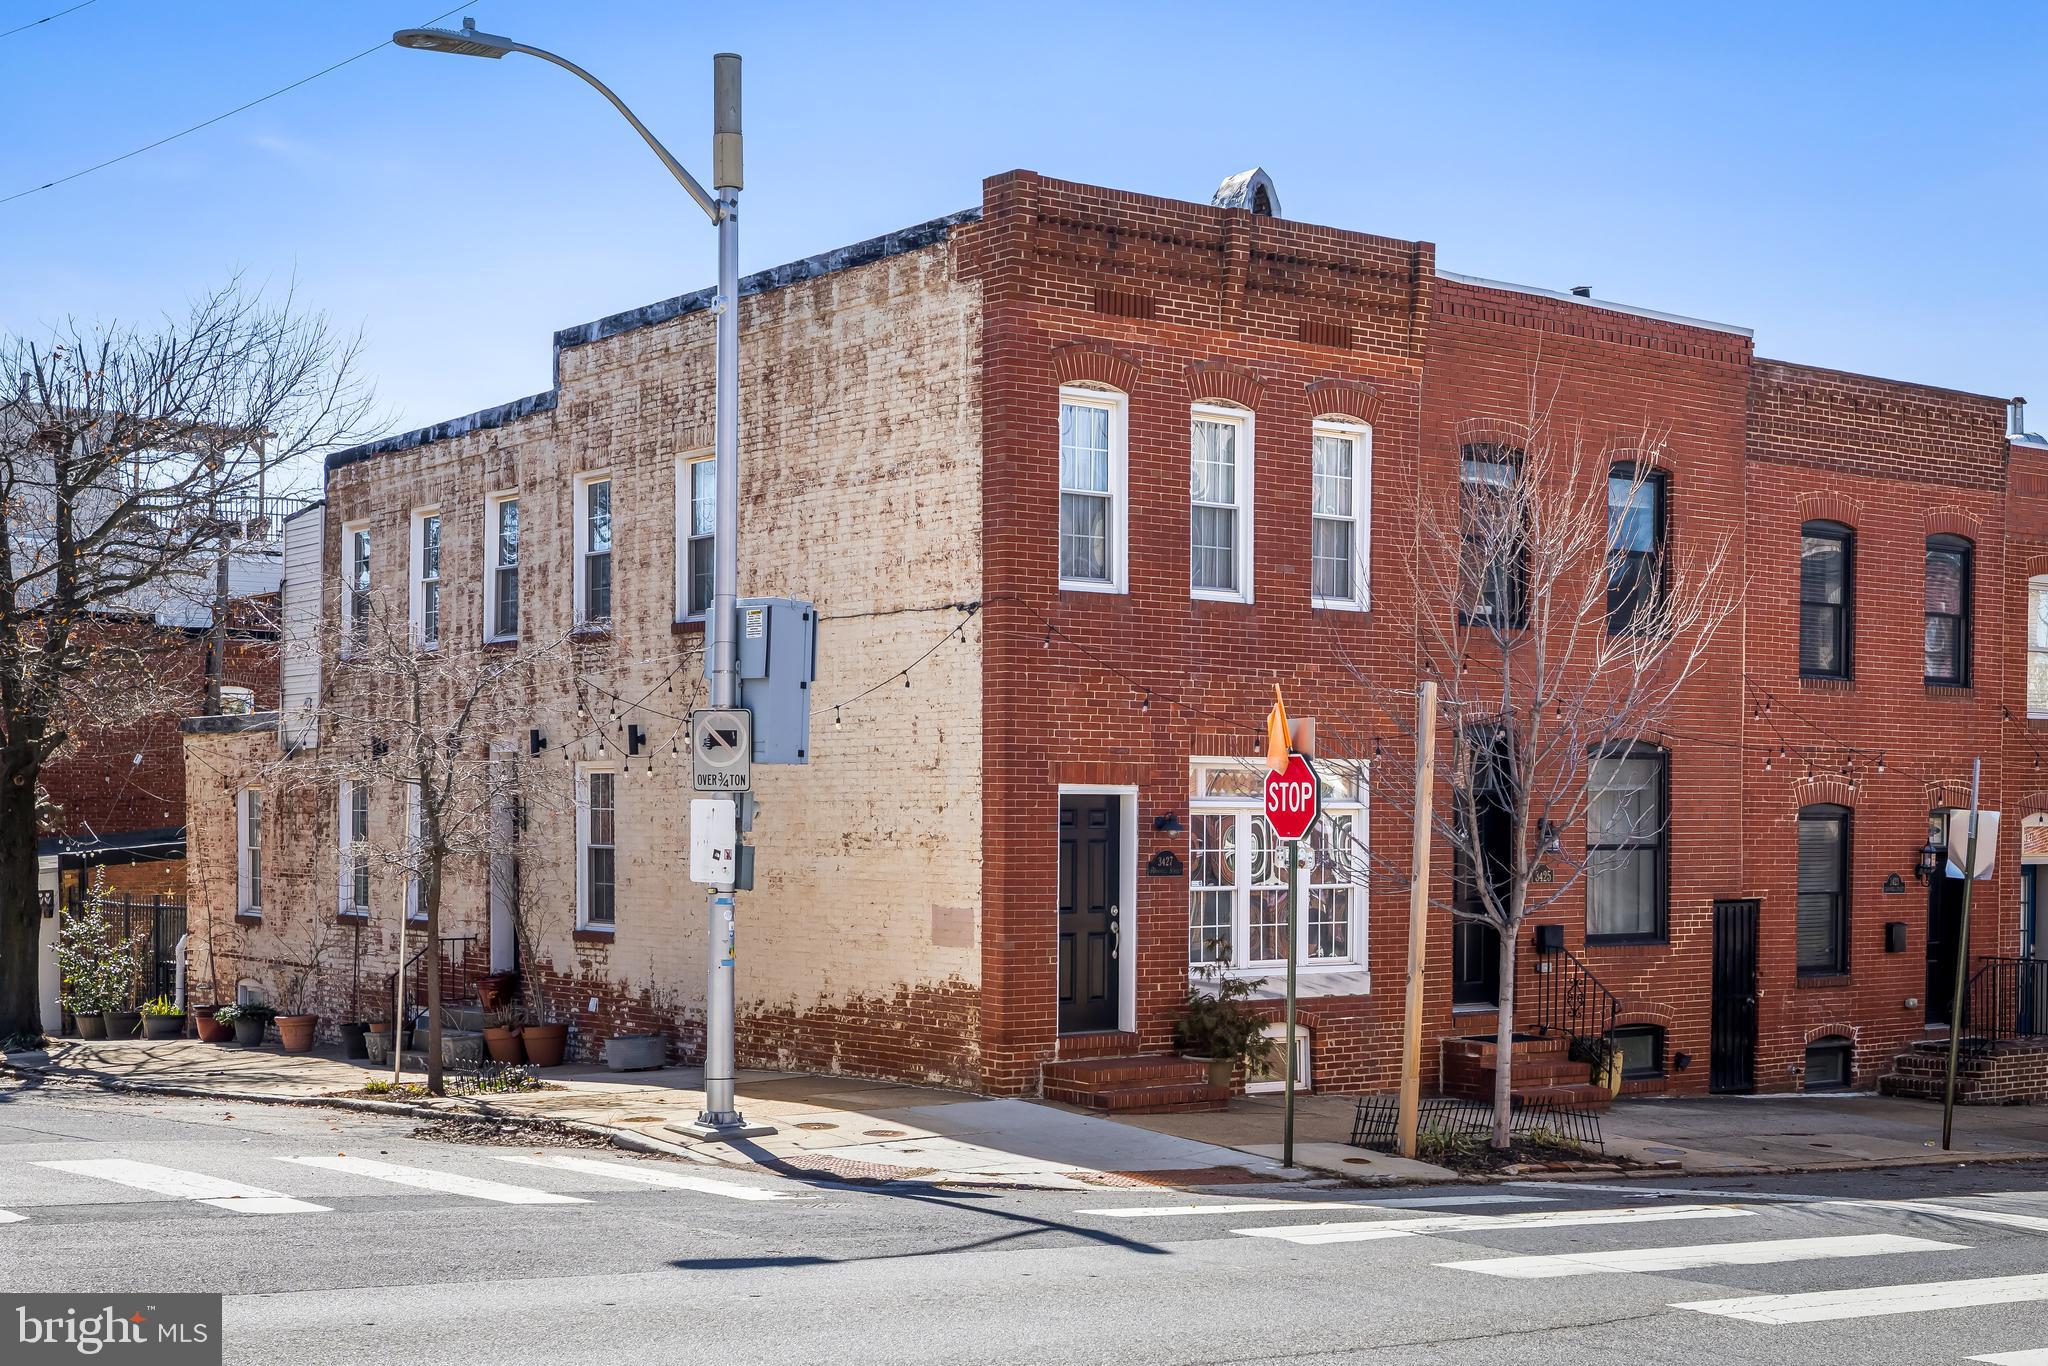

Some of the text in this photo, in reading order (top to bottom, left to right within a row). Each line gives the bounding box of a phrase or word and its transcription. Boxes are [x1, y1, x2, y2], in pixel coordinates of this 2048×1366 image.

[697, 774, 717, 786] OVER
[729, 774, 746, 786] TON
[1268, 781, 1312, 812] STOP
[1157, 856, 1174, 867] 3427
[1535, 870, 1551, 882] 3425
